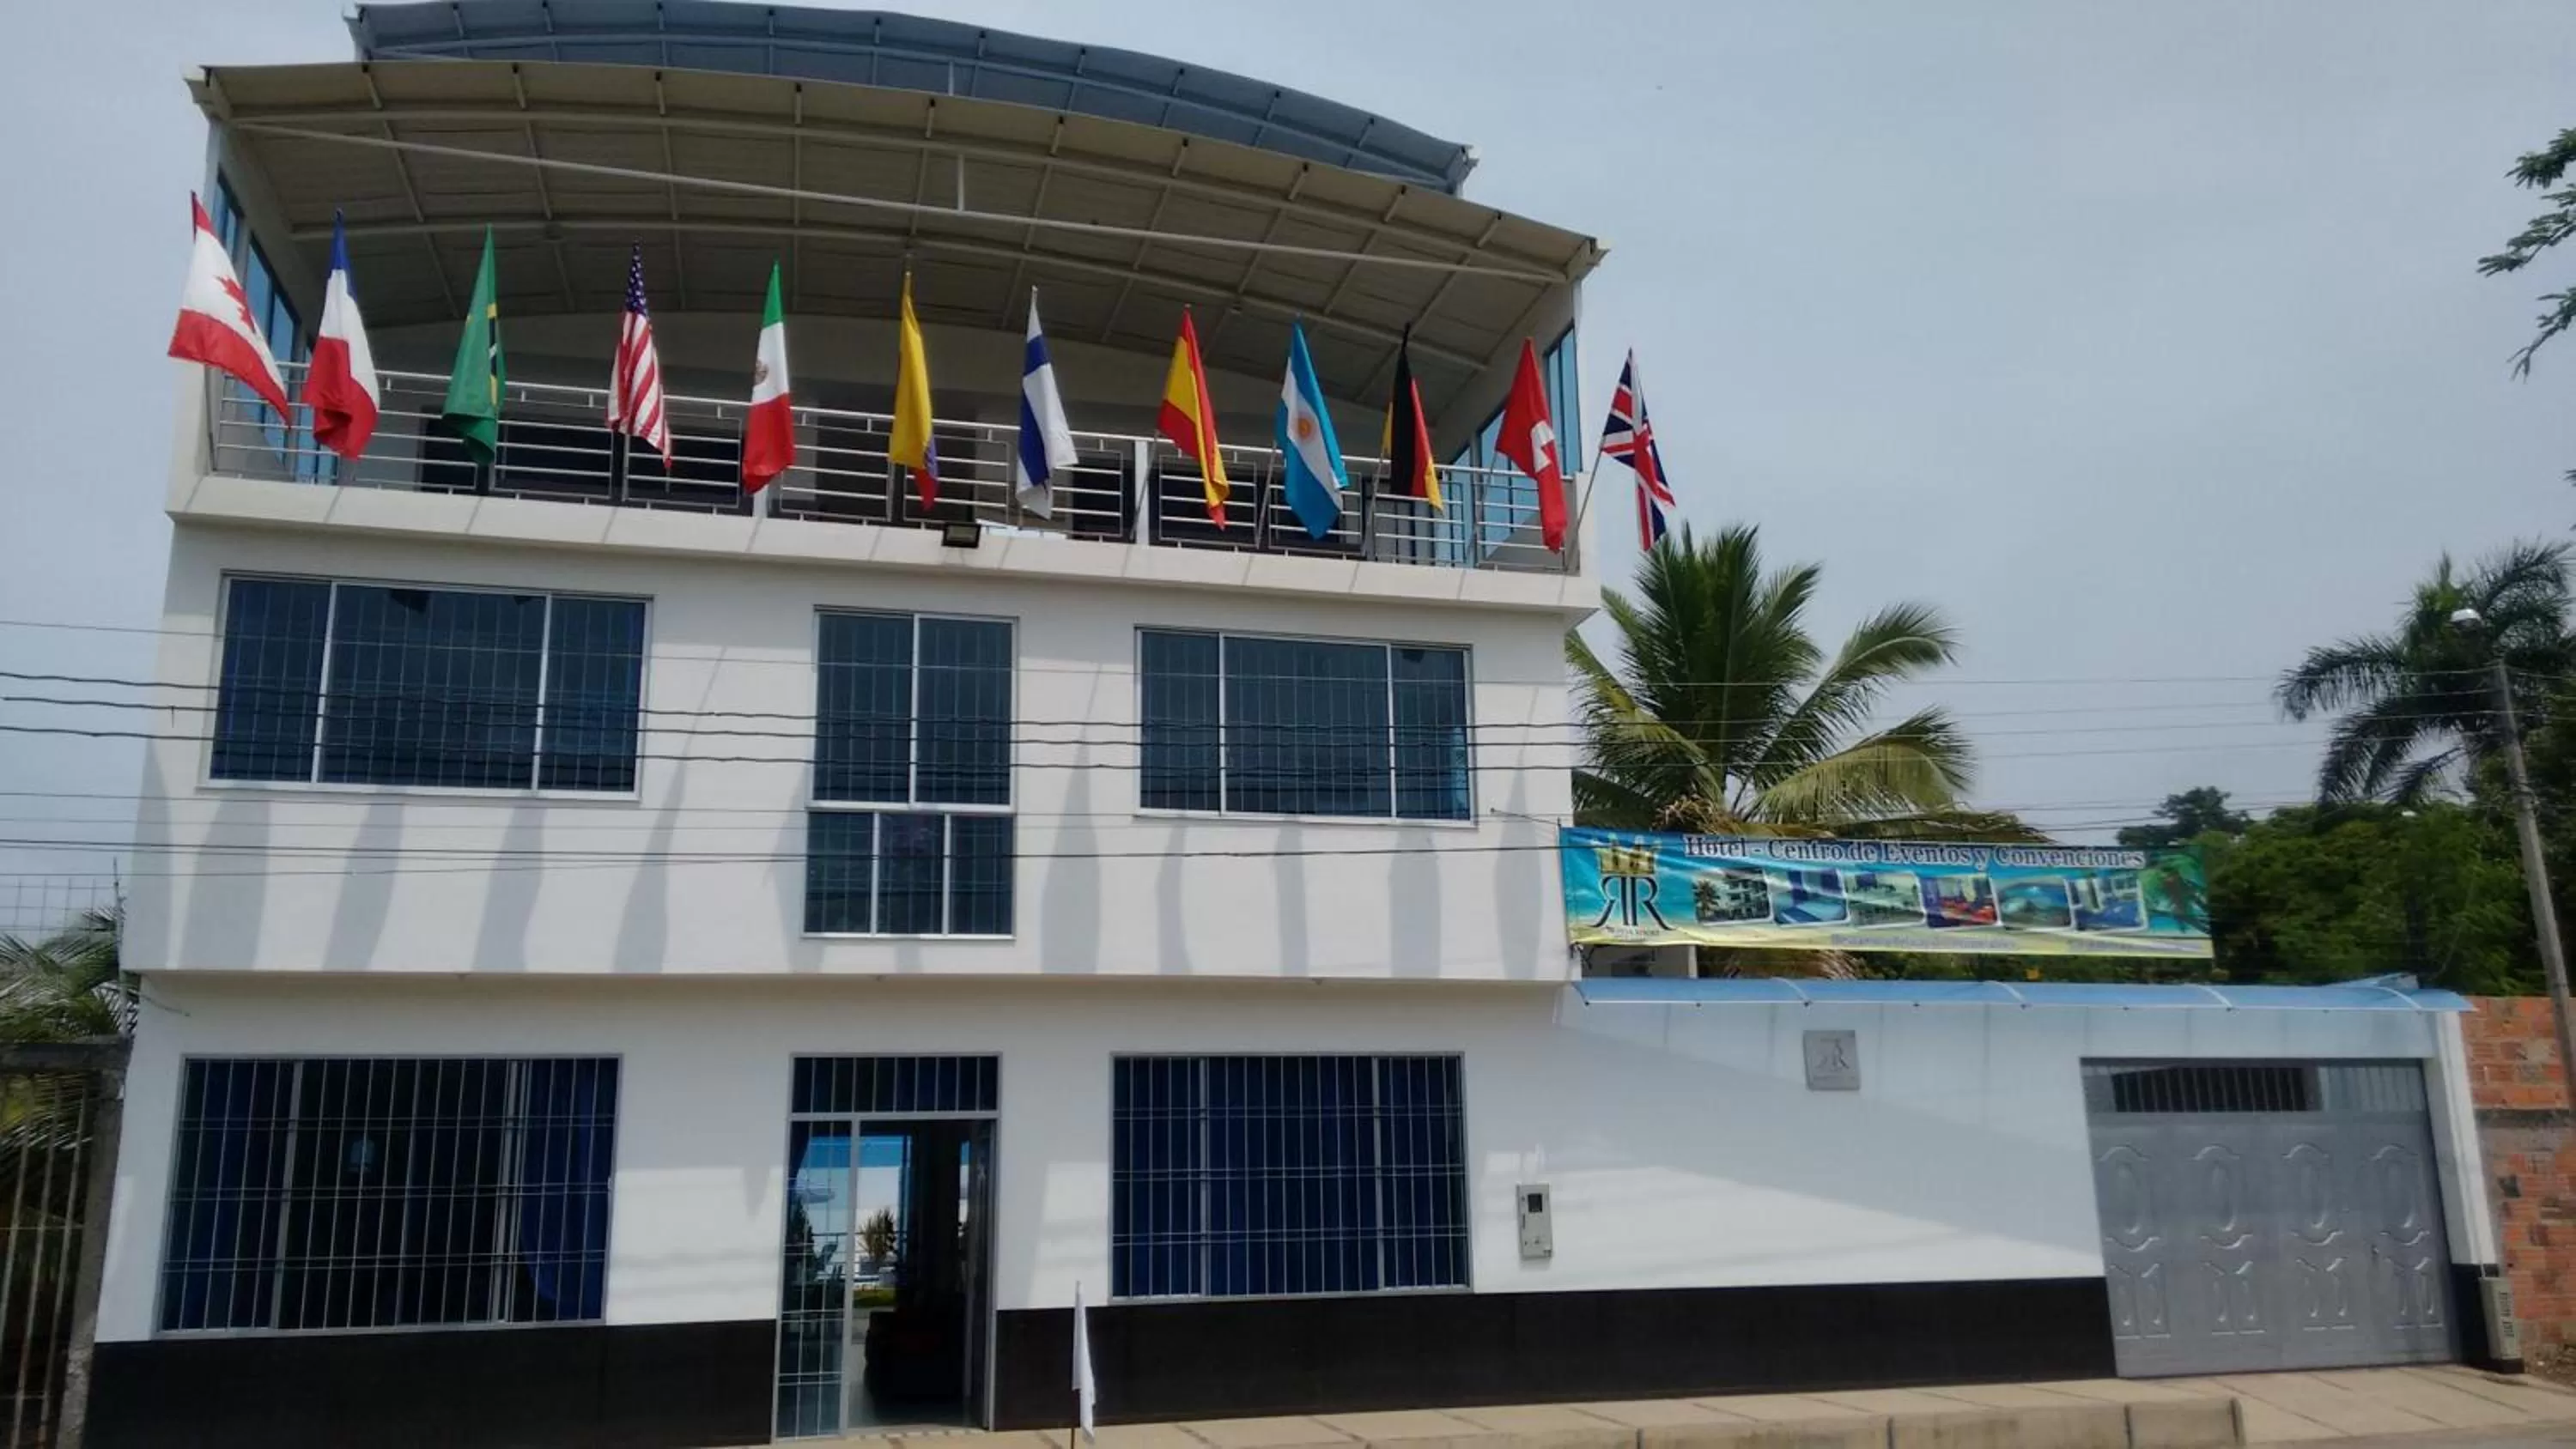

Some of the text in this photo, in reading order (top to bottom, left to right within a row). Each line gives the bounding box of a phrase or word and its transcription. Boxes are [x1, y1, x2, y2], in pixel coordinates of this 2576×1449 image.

[1686, 835, 1747, 858] Hotel
[1768, 839, 1843, 861] Centro
[1849, 840, 1876, 862] de
[1883, 842, 1969, 865] Eventos
[1974, 849, 1990, 870] y
[1994, 845, 2144, 869] Convenciones
